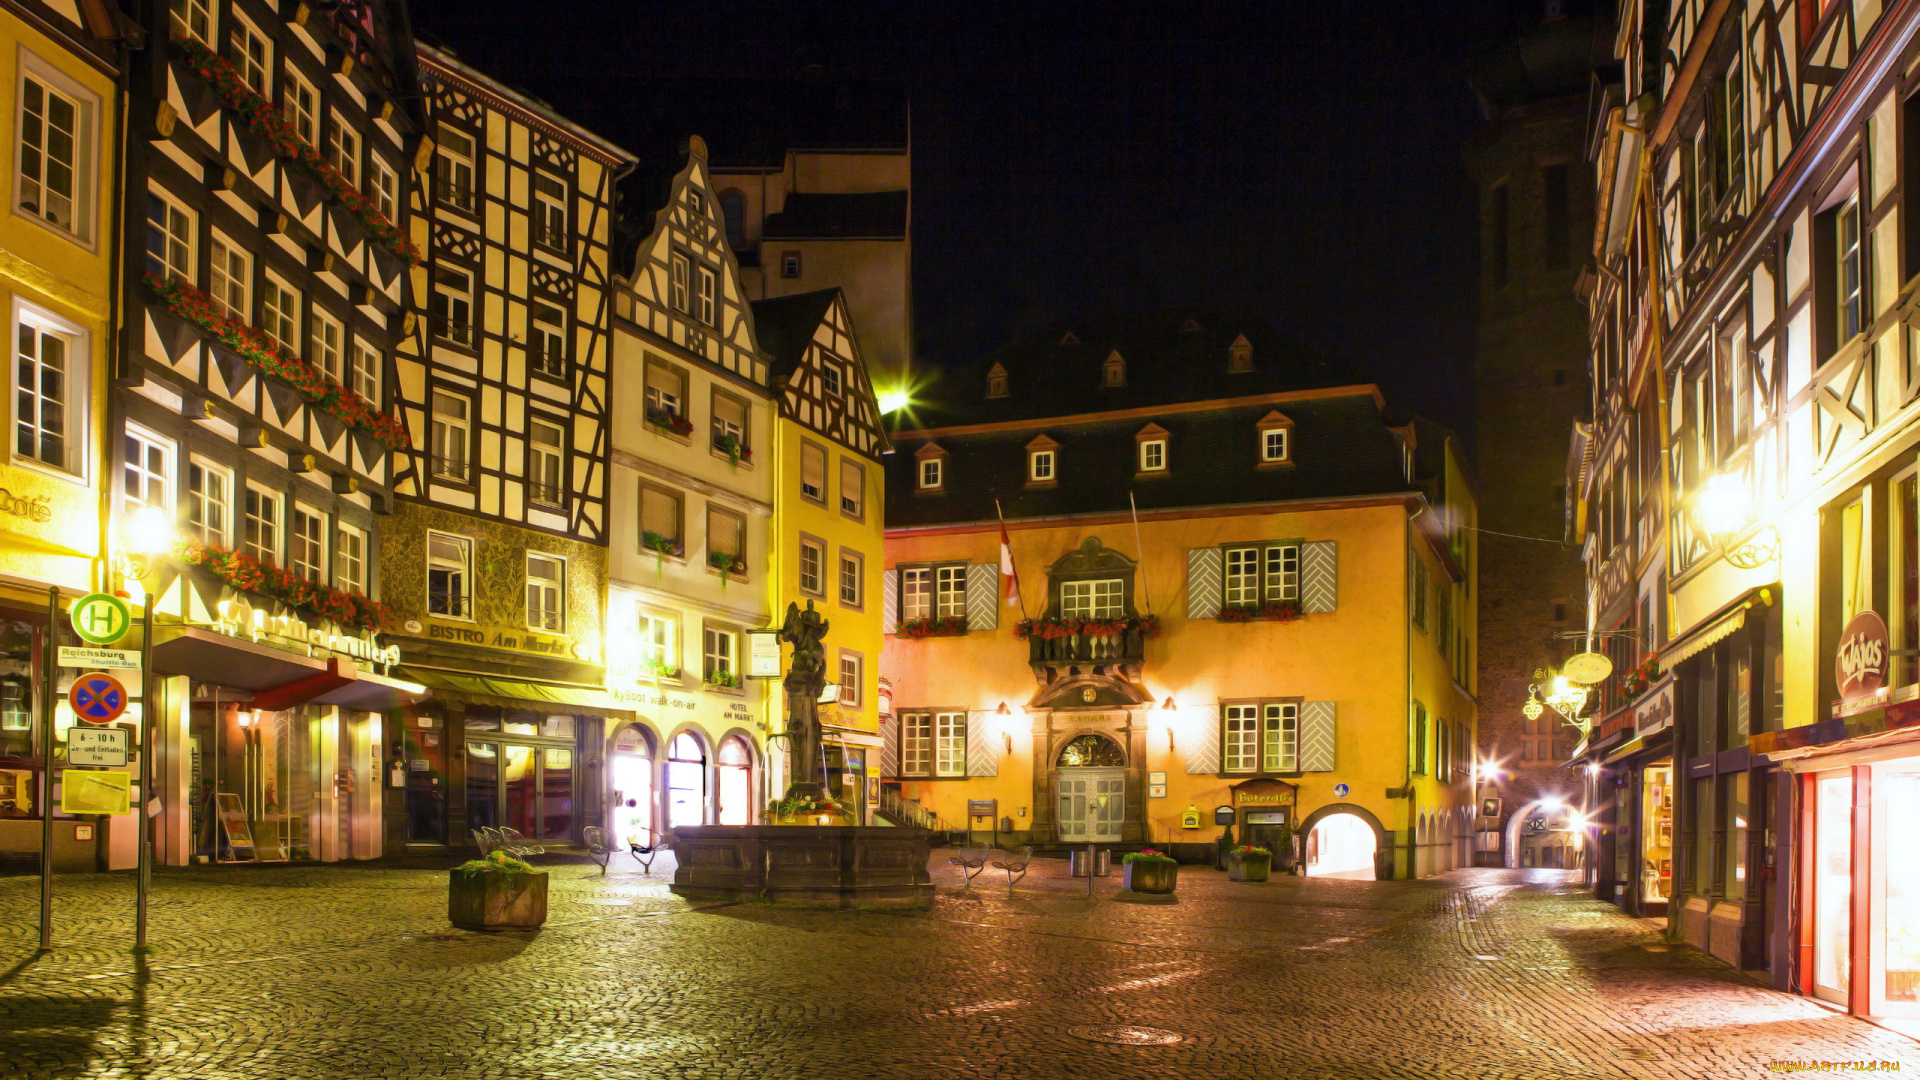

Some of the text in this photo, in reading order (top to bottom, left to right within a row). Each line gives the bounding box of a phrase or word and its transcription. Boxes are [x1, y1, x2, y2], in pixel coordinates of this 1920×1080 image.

[90, 604, 113, 633] H
[430, 624, 485, 644] BISTRO
[492, 632, 517, 649] Am
[521, 635, 567, 655] Markt
[62, 648, 125, 660] Reichsburg
[614, 689, 646, 704] kyBoot
[729, 702, 748, 712] HOTEL
[723, 711, 754, 722] AM MARKT
[1065, 714, 1112, 722] RATHAUS
[98, 733, 107, 742] 10
